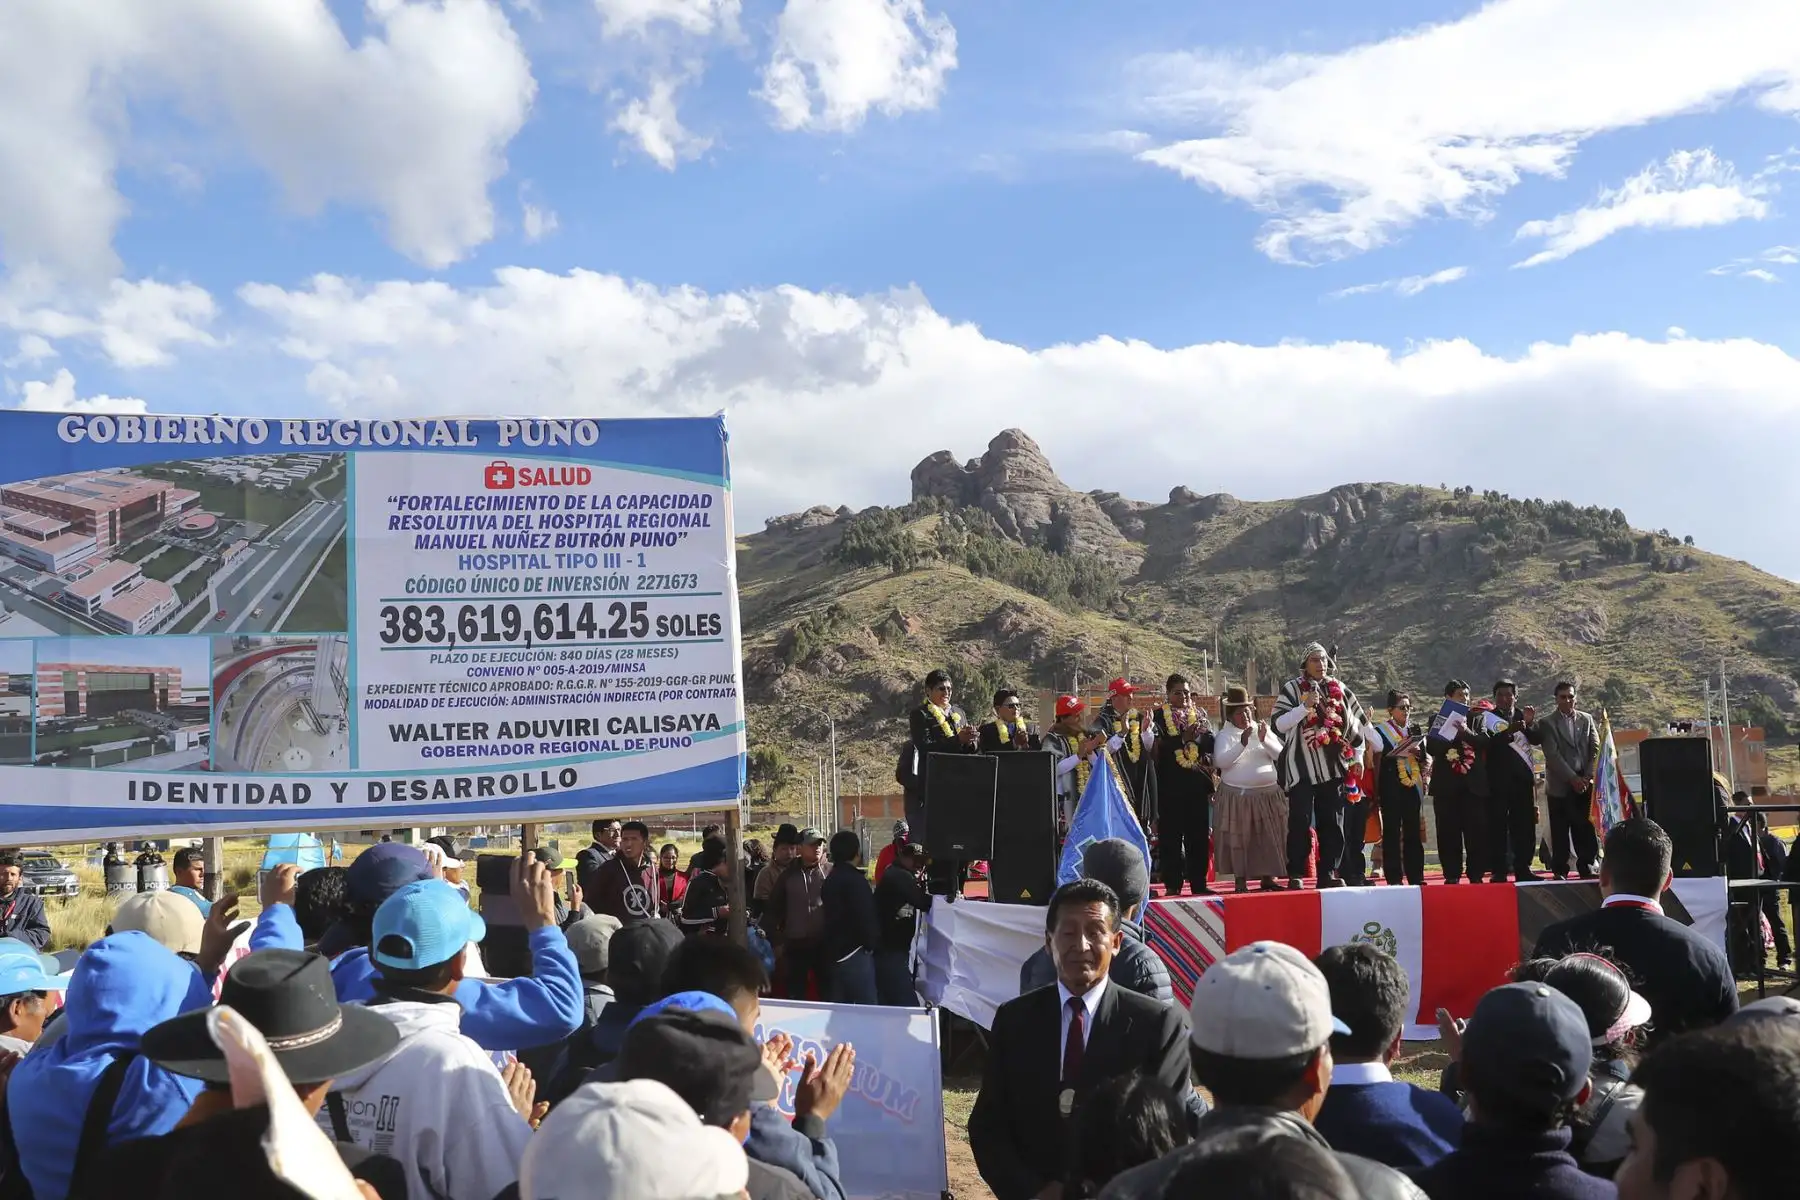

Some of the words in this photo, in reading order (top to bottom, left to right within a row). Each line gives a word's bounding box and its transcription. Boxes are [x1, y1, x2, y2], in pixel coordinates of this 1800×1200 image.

[57, 416, 269, 445] GOBIERNO
[279, 420, 479, 447] REGIONAL
[497, 419, 600, 447] PUNO
[518, 467, 592, 486] SALUD
[564, 495, 587, 510] DE
[591, 495, 612, 510] LA
[616, 494, 713, 509] CAPACIDAD
[388, 515, 497, 530] RESOLUTIVA
[502, 514, 534, 530] DEL
[538, 513, 622, 530] HOSPITAL
[627, 512, 711, 529] REGIONAL
[414, 534, 487, 550] MANUEL
[492, 530, 552, 549] NUÑEZ
[554, 529, 626, 549] BUTRÓN
[458, 554, 551, 570] HOSPITAL
[555, 553, 598, 569] TIPO
[603, 553, 621, 568] III
[637, 552, 647, 568] 1
[405, 574, 467, 594] CÓDIGO
[471, 574, 520, 593] ÚNICO
[523, 577, 544, 592] DE
[547, 572, 630, 592] INVERSIÓN
[636, 573, 698, 590] 2271673
[379, 601, 650, 651] 383,619,614.25
[656, 613, 722, 637] SOLES
[430, 653, 469, 664] PLAZO
[472, 653, 487, 663] DE
[490, 649, 557, 663] EJECUCIÓN:
[559, 650, 583, 661] 840
[585, 648, 612, 661] DÍAS
[615, 649, 634, 661] (28
[636, 647, 679, 659] MESES)
[467, 667, 525, 678] CONVENIO
[543, 663, 646, 676] 005-A-2019/MINSA
[367, 684, 437, 695] EXPEDIENTE
[438, 681, 488, 694] TÉCNICO
[489, 679, 554, 692] APROBADO:
[556, 680, 597, 690] R.G.G.R.
[615, 675, 706, 688] 155-2019-GGR-GR
[364, 698, 429, 710] MODALIDAD
[431, 697, 445, 708] DE
[447, 693, 509, 708] EJECUCIÓN:
[511, 692, 600, 707] ADMINISTRACIÓN
[603, 691, 656, 703] INDIRECTA
[658, 689, 684, 703] (POR
[686, 687, 737, 700] CONTRATA
[389, 722, 489, 742] WALTER
[497, 718, 600, 740] ADUVIRI
[606, 713, 721, 734] CALISAYA
[420, 743, 536, 758] GOBERNADOR
[539, 739, 620, 753] REGIONAL
[623, 739, 646, 751] DE
[648, 736, 693, 750] PUNO
[128, 780, 312, 804] IDENTIDAD
[330, 782, 349, 803] Y
[367, 767, 578, 803] DESARROLLO
